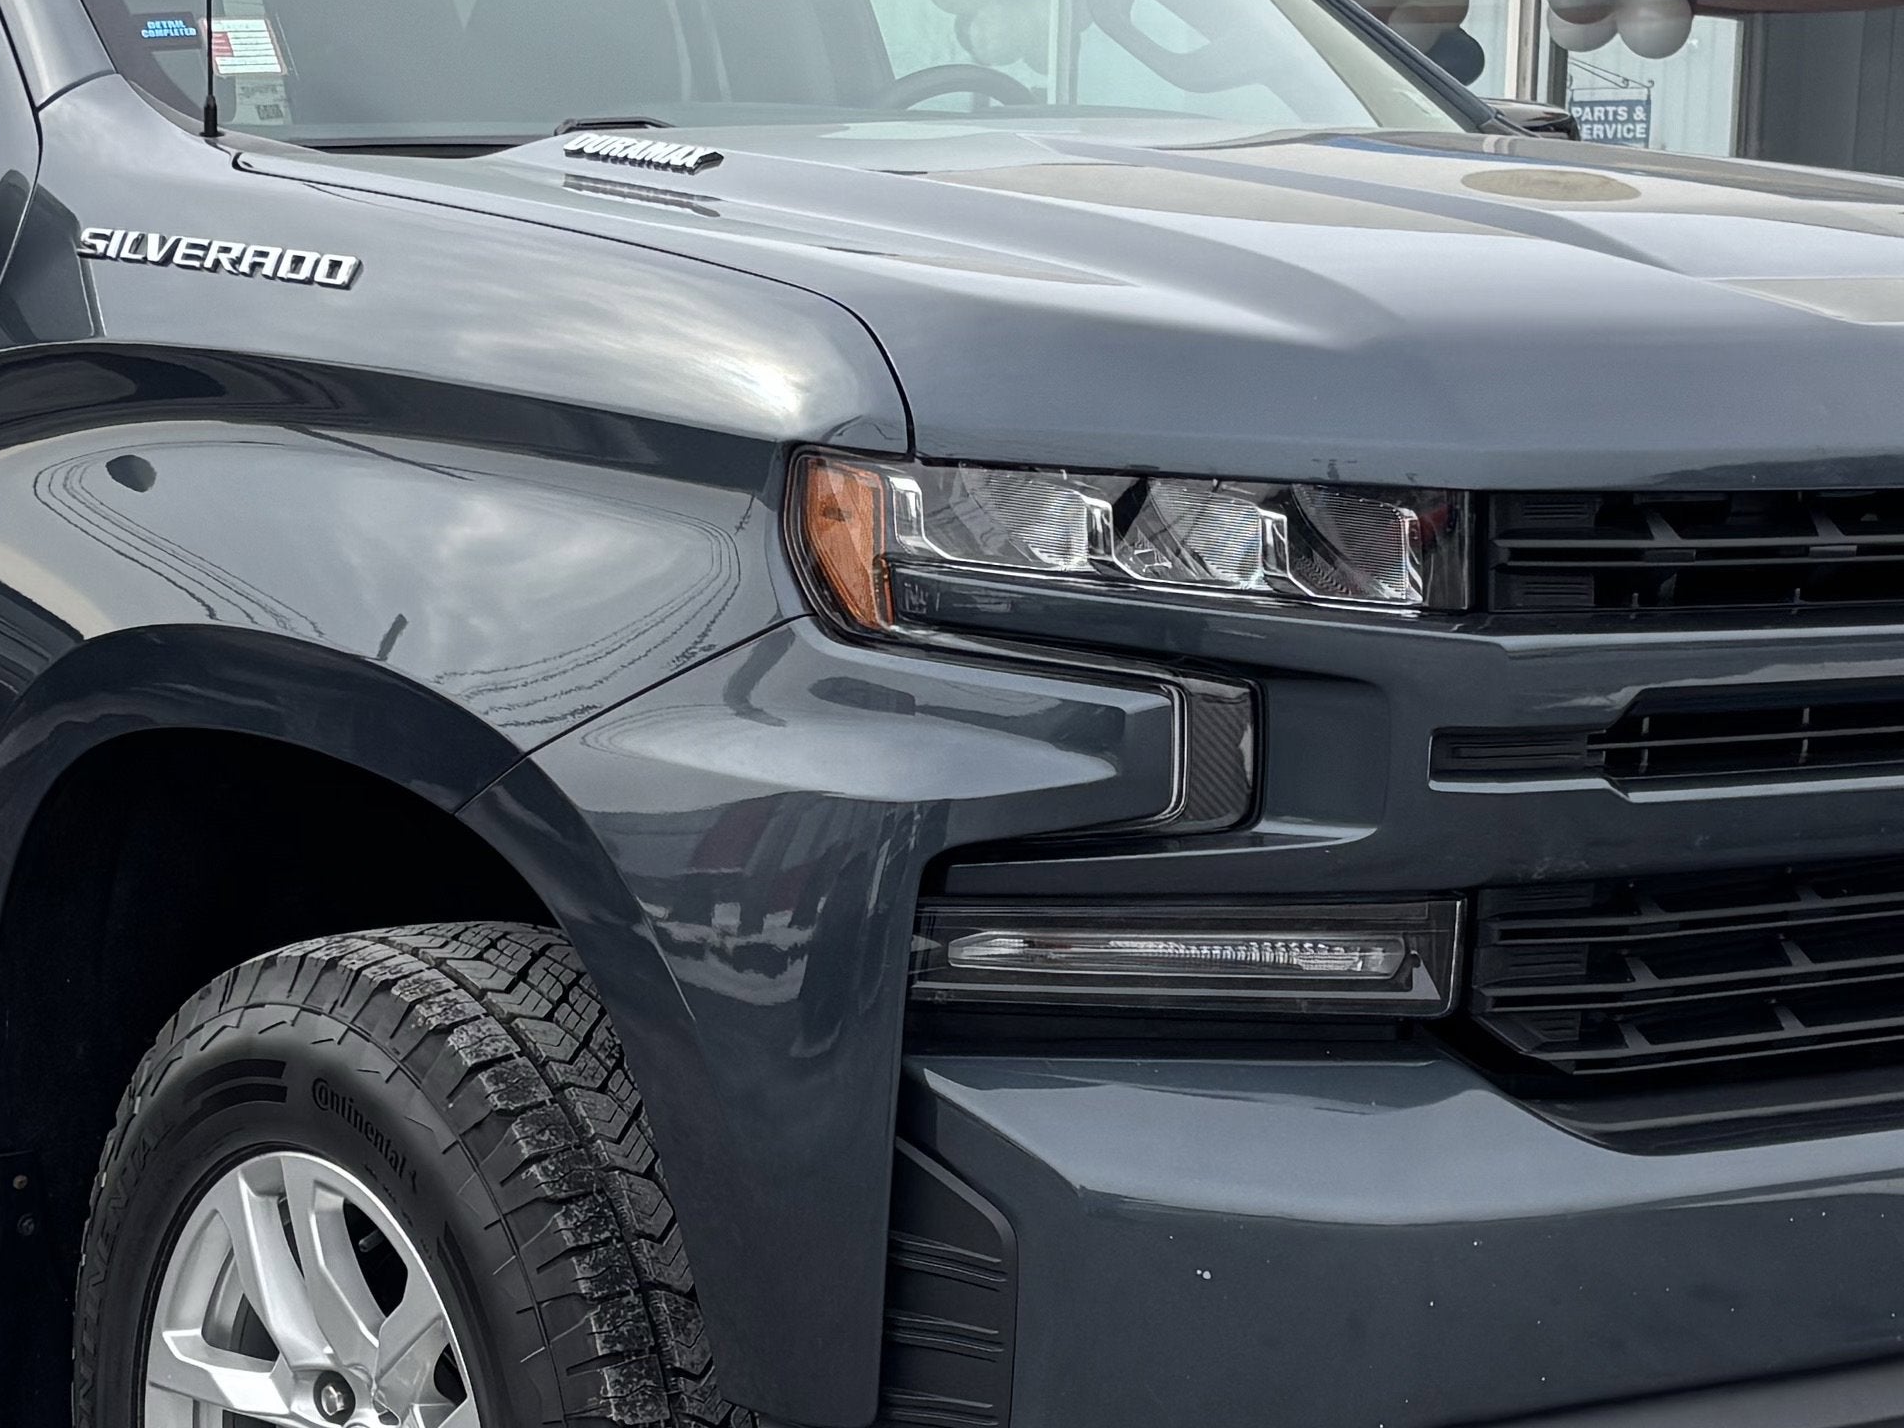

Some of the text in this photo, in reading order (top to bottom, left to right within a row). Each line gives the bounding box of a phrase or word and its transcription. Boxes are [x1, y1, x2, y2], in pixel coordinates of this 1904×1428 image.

[141, 27, 197, 39] COMPLETED
[147, 19, 186, 29] DETAIL
[1571, 105, 1647, 122] PARTS &
[1578, 122, 1648, 140] ERVICE
[563, 132, 720, 172] DURAMAX
[77, 227, 363, 290] SILVERADO
[311, 1076, 407, 1180] Continental
